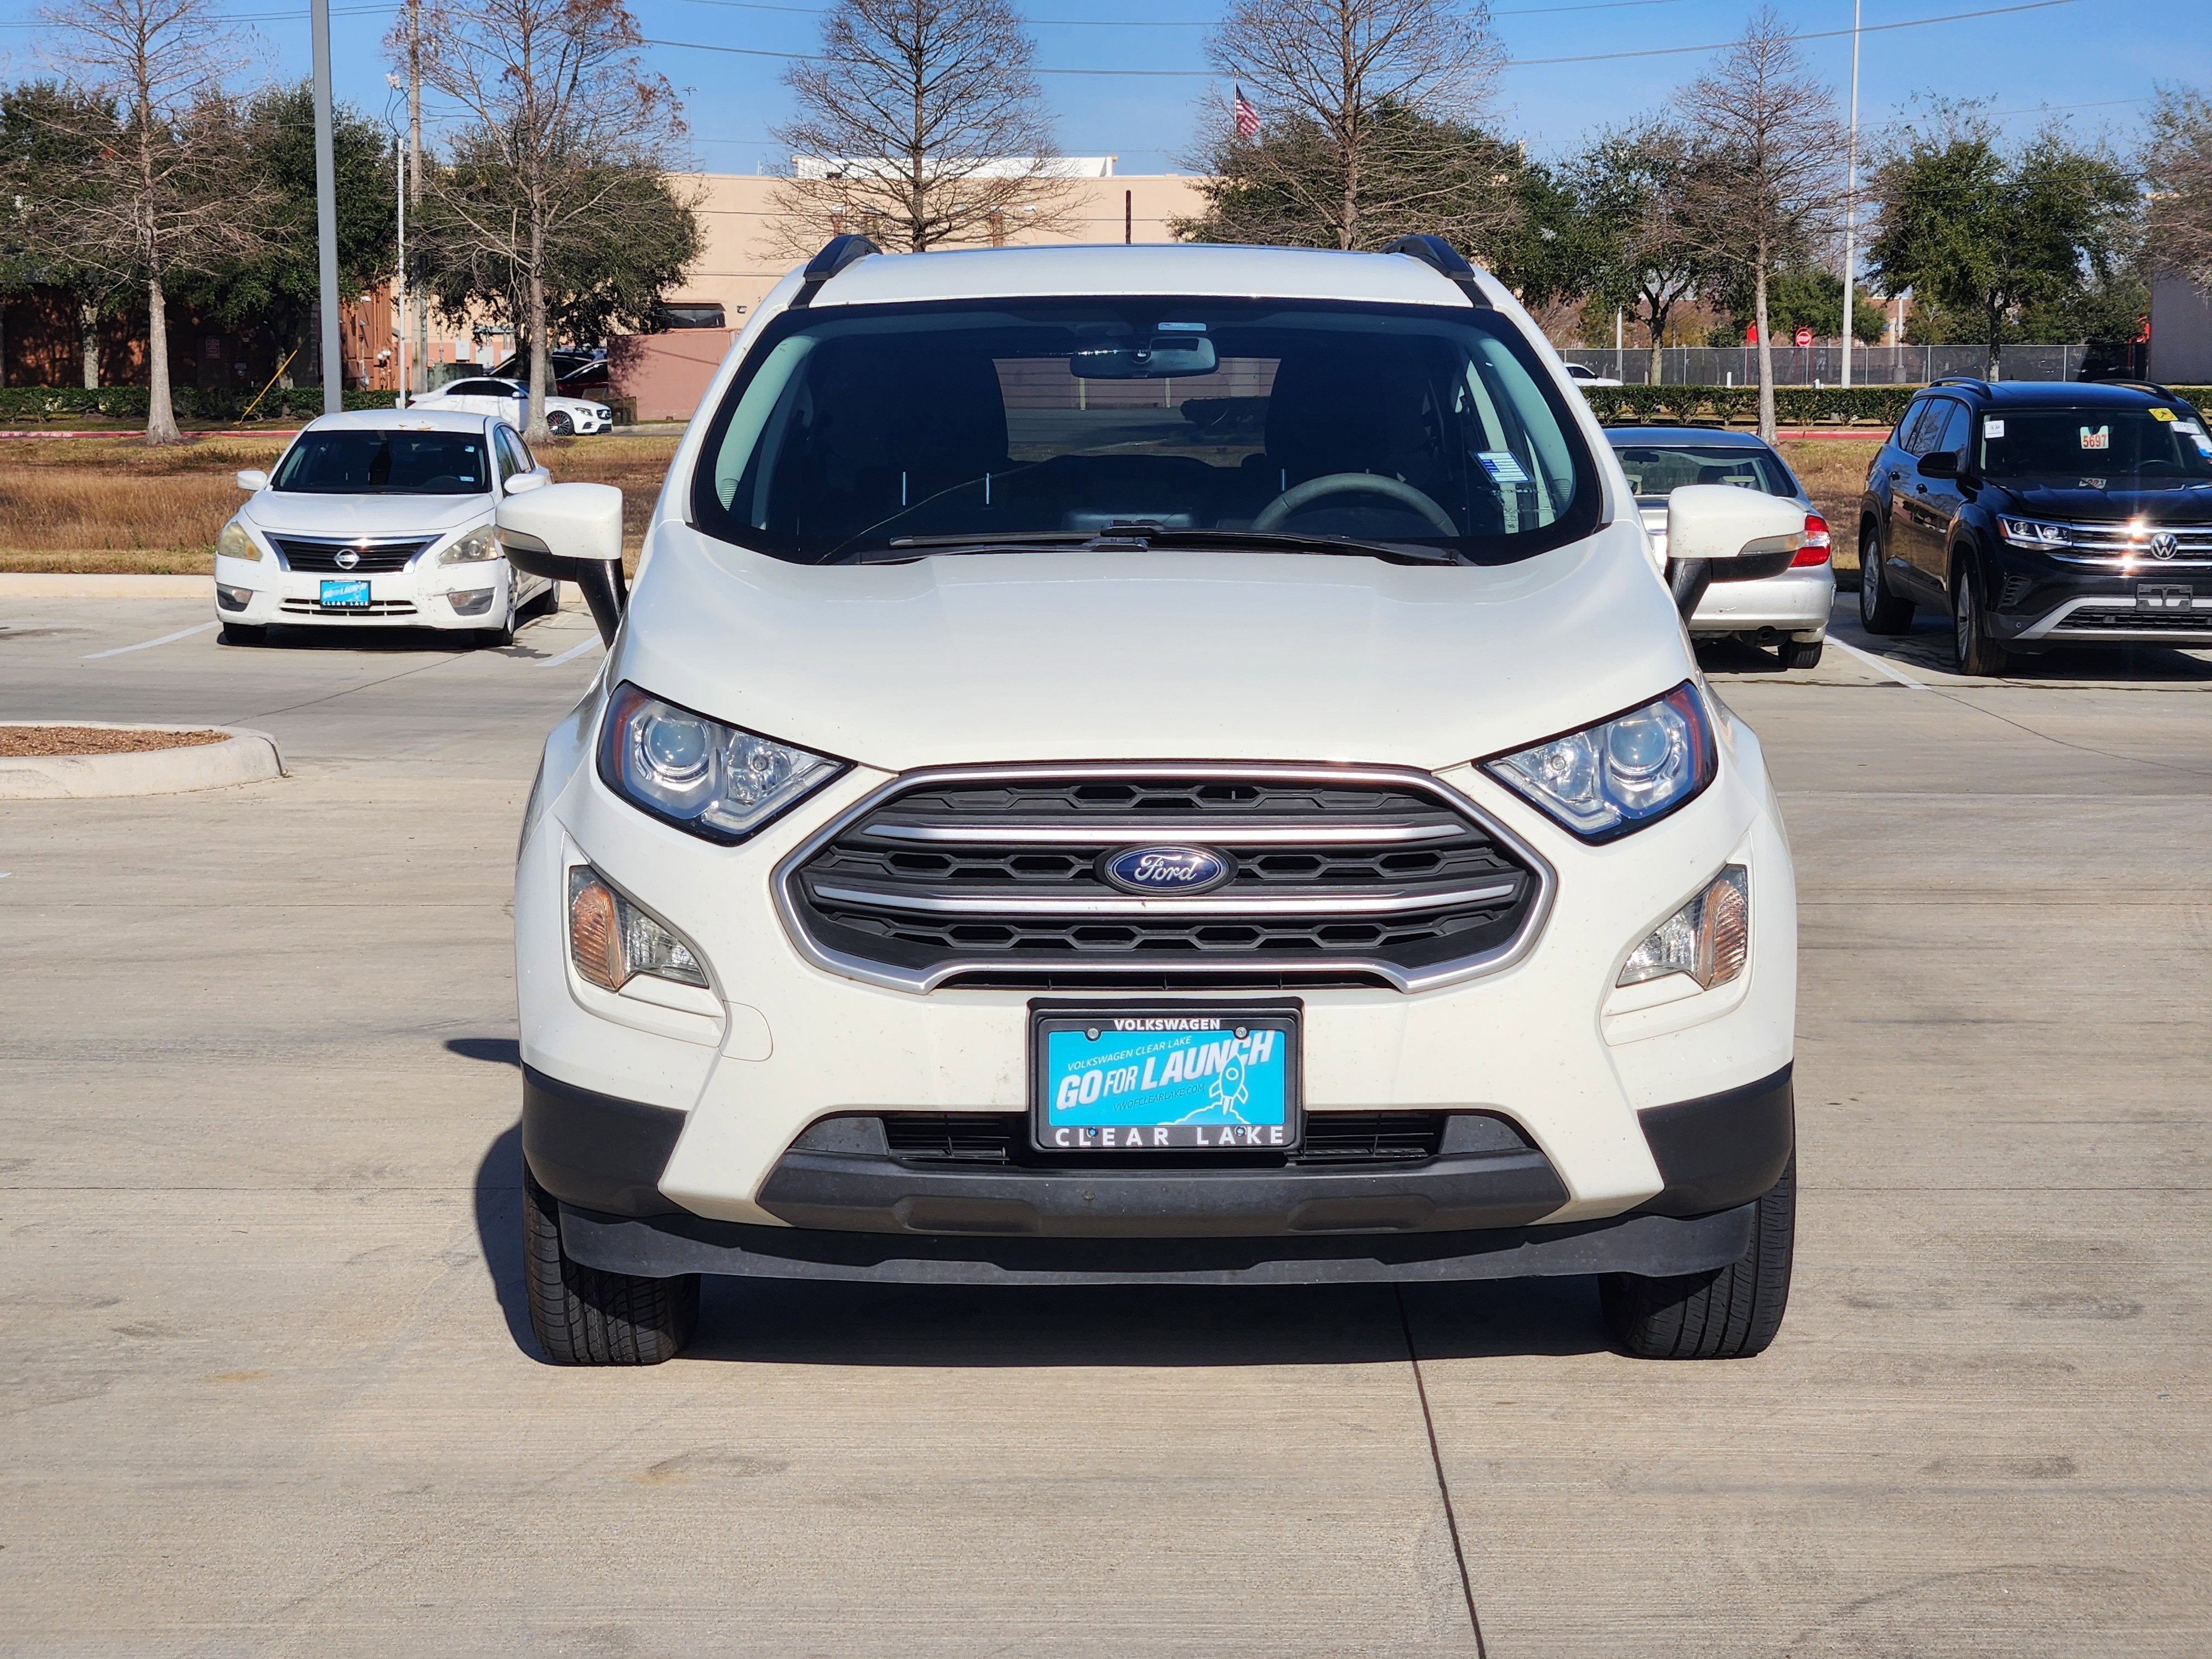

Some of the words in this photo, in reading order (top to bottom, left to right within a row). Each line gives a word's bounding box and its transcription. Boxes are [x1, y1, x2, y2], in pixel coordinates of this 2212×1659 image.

[2083, 434, 2106, 447] 5697
[1134, 854, 1203, 881] Ford
[1114, 1019, 1220, 1030] VOLKSWAGEN
[1068, 1049, 1133, 1071] VOLKSWAGEN
[1135, 1042, 1165, 1056] CLEAR
[1167, 1036, 1192, 1048] LAKE
[1056, 1070, 1103, 1110] GO
[1103, 1065, 1139, 1097] FOR
[1140, 1030, 1276, 1091] LAUNCH
[1113, 1083, 1206, 1112] VWOFCLEARLAKE.COM
[1055, 1128, 1170, 1146] CLEAR
[1196, 1126, 1284, 1146] LAKE
